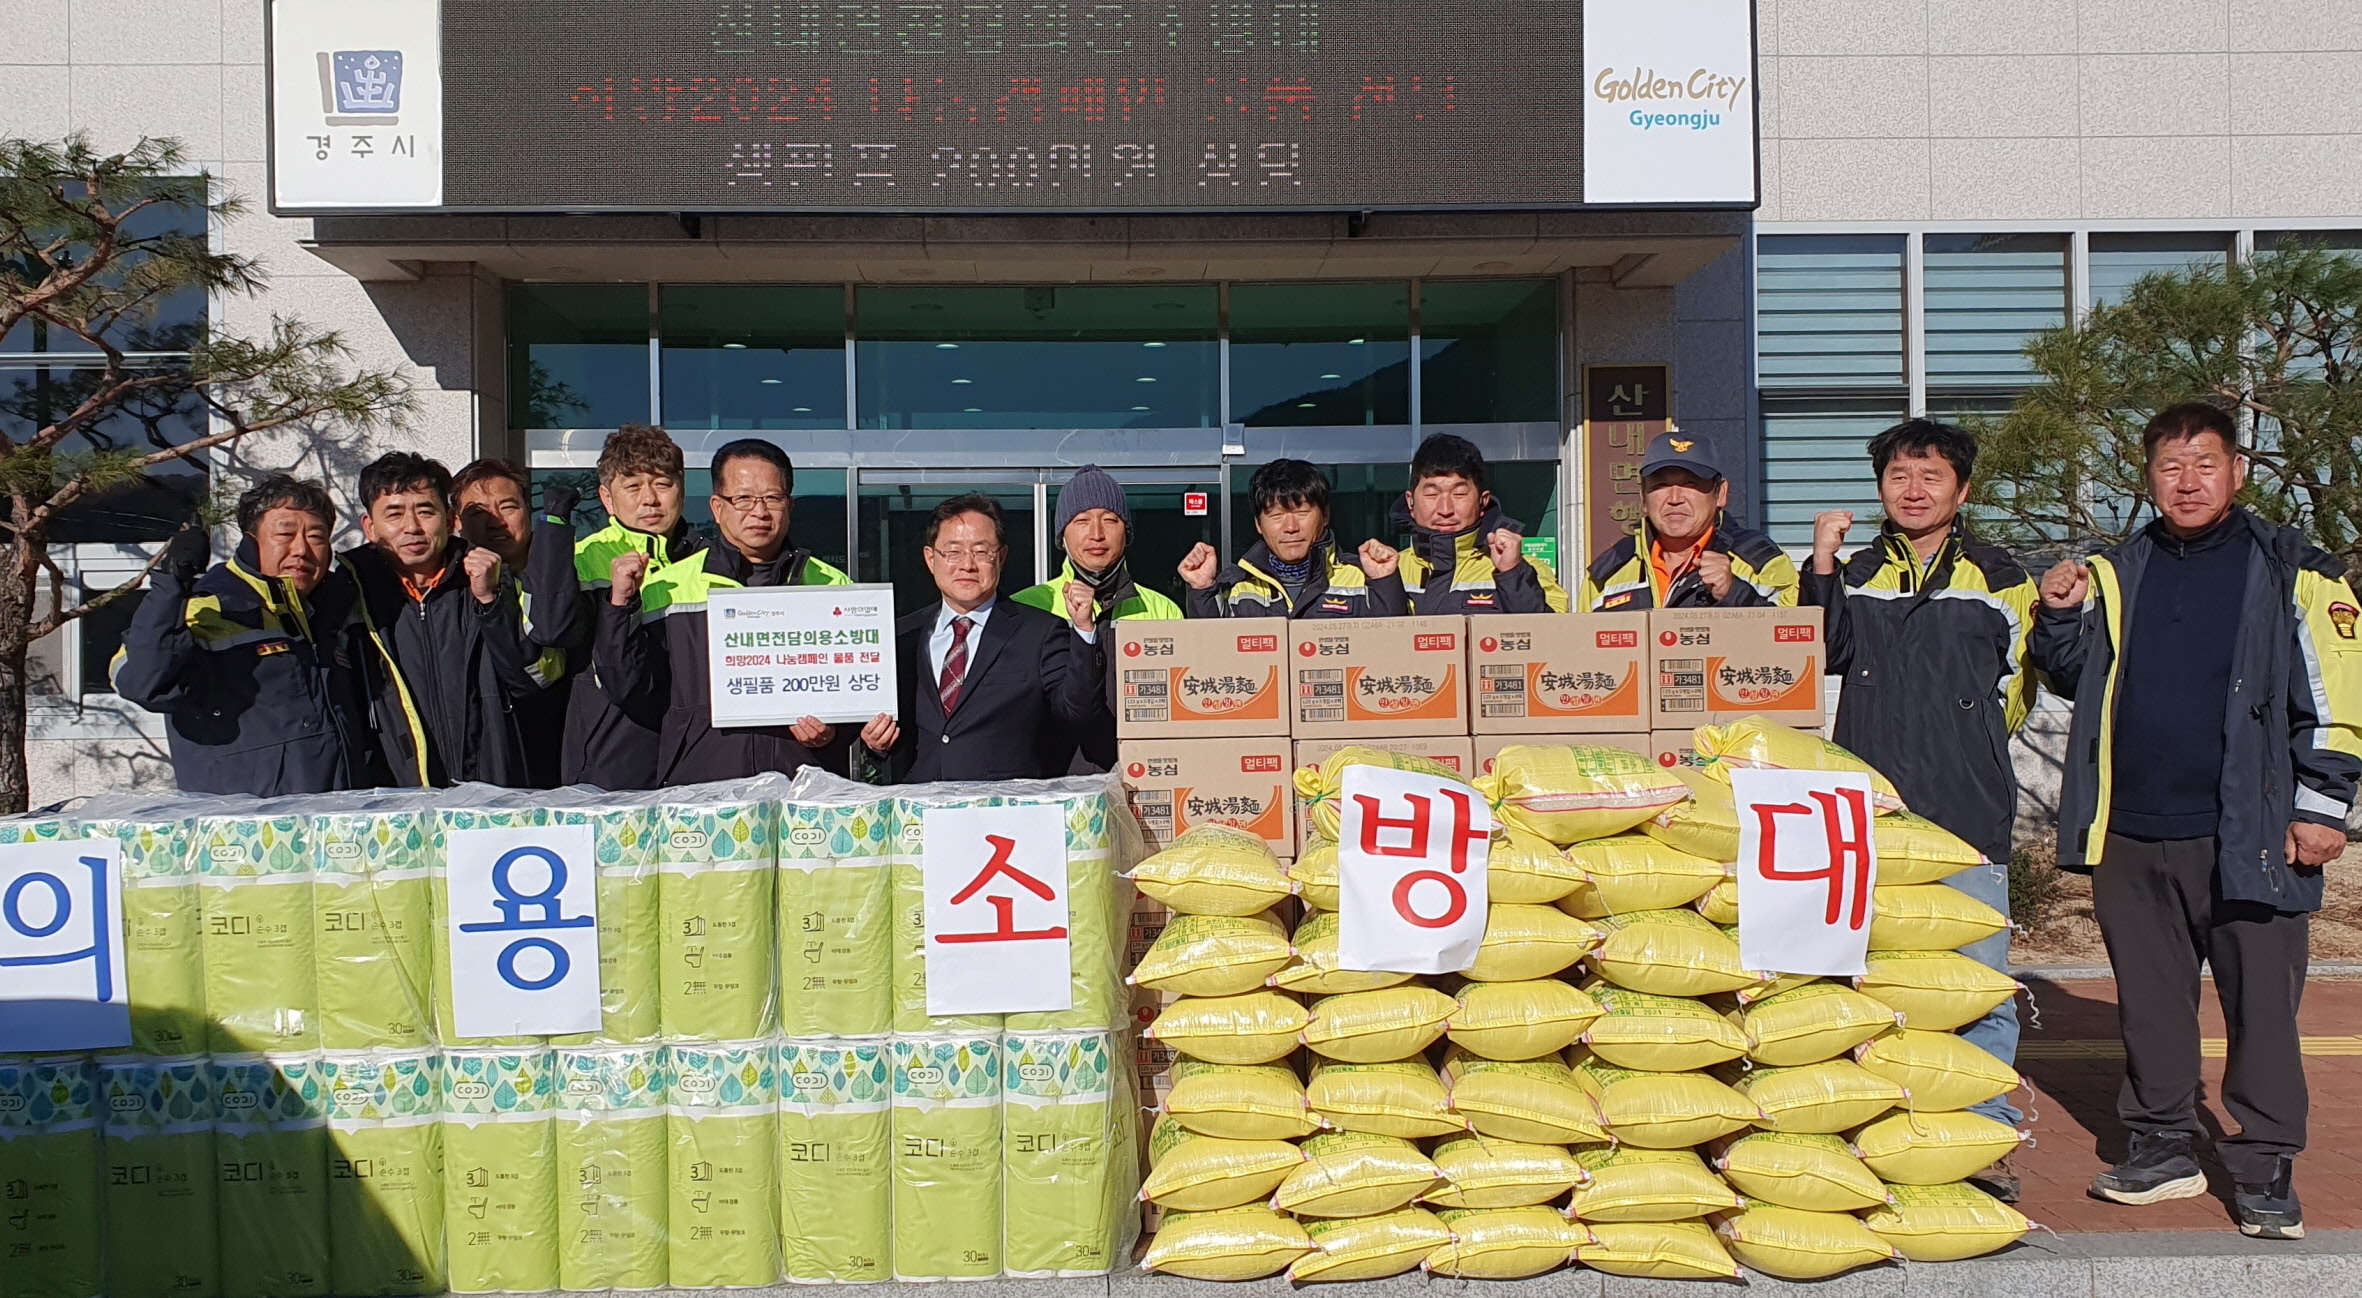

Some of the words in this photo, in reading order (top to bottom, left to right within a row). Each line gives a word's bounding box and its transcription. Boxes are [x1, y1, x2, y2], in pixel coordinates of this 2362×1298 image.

[1594, 67, 1683, 103] Golden
[1687, 68, 1746, 112] City
[1629, 109, 1720, 130] Gyeongju
[306, 135, 414, 160] 경주시
[724, 629, 879, 648] 산내면전담의용소방대
[1600, 633, 1634, 645] 멀티팩
[1679, 633, 1710, 645] 농심
[1777, 627, 1811, 639] 멀티팩
[1241, 638, 1274, 649] 멀티팩
[1417, 636, 1451, 648] 멀티팩
[1500, 639, 1531, 651] 농심
[1144, 644, 1174, 656] 농심
[1319, 643, 1349, 656] 농심
[725, 654, 771, 667] 희망2024
[776, 653, 829, 666] 나눔캠페인
[833, 653, 854, 664] 물품
[860, 651, 880, 663] 전달
[727, 677, 775, 695] 생필품
[782, 674, 840, 693] 200만원
[848, 673, 880, 691] 상당
[1496, 681, 1522, 690] 가3481
[1675, 676, 1701, 685] 가3481
[1140, 686, 1166, 695] 가3481
[1315, 685, 1341, 695] 가3481
[1147, 764, 1178, 777] 농심
[1244, 758, 1278, 770] 멀티팩
[1144, 807, 1170, 815] 가3481
[1352, 787, 1488, 929] 방
[1749, 786, 1870, 931] 대
[934, 834, 1068, 944] 소
[324, 912, 365, 932] 코디
[459, 845, 595, 991] 용
[0, 856, 112, 1003] 의
[210, 916, 250, 936] 코디
[388, 1022, 402, 1035] 30
[1152, 1051, 1177, 1062] 가348
[904, 1138, 944, 1157] 코디
[1016, 1134, 1055, 1152] 코디
[791, 1143, 829, 1162] 코디
[111, 1165, 151, 1186] 코디
[222, 1162, 263, 1182] 코디
[334, 1159, 374, 1179] 코디
[963, 1250, 978, 1263] 30
[1075, 1245, 1090, 1257] 30
[849, 1256, 863, 1268] 30
